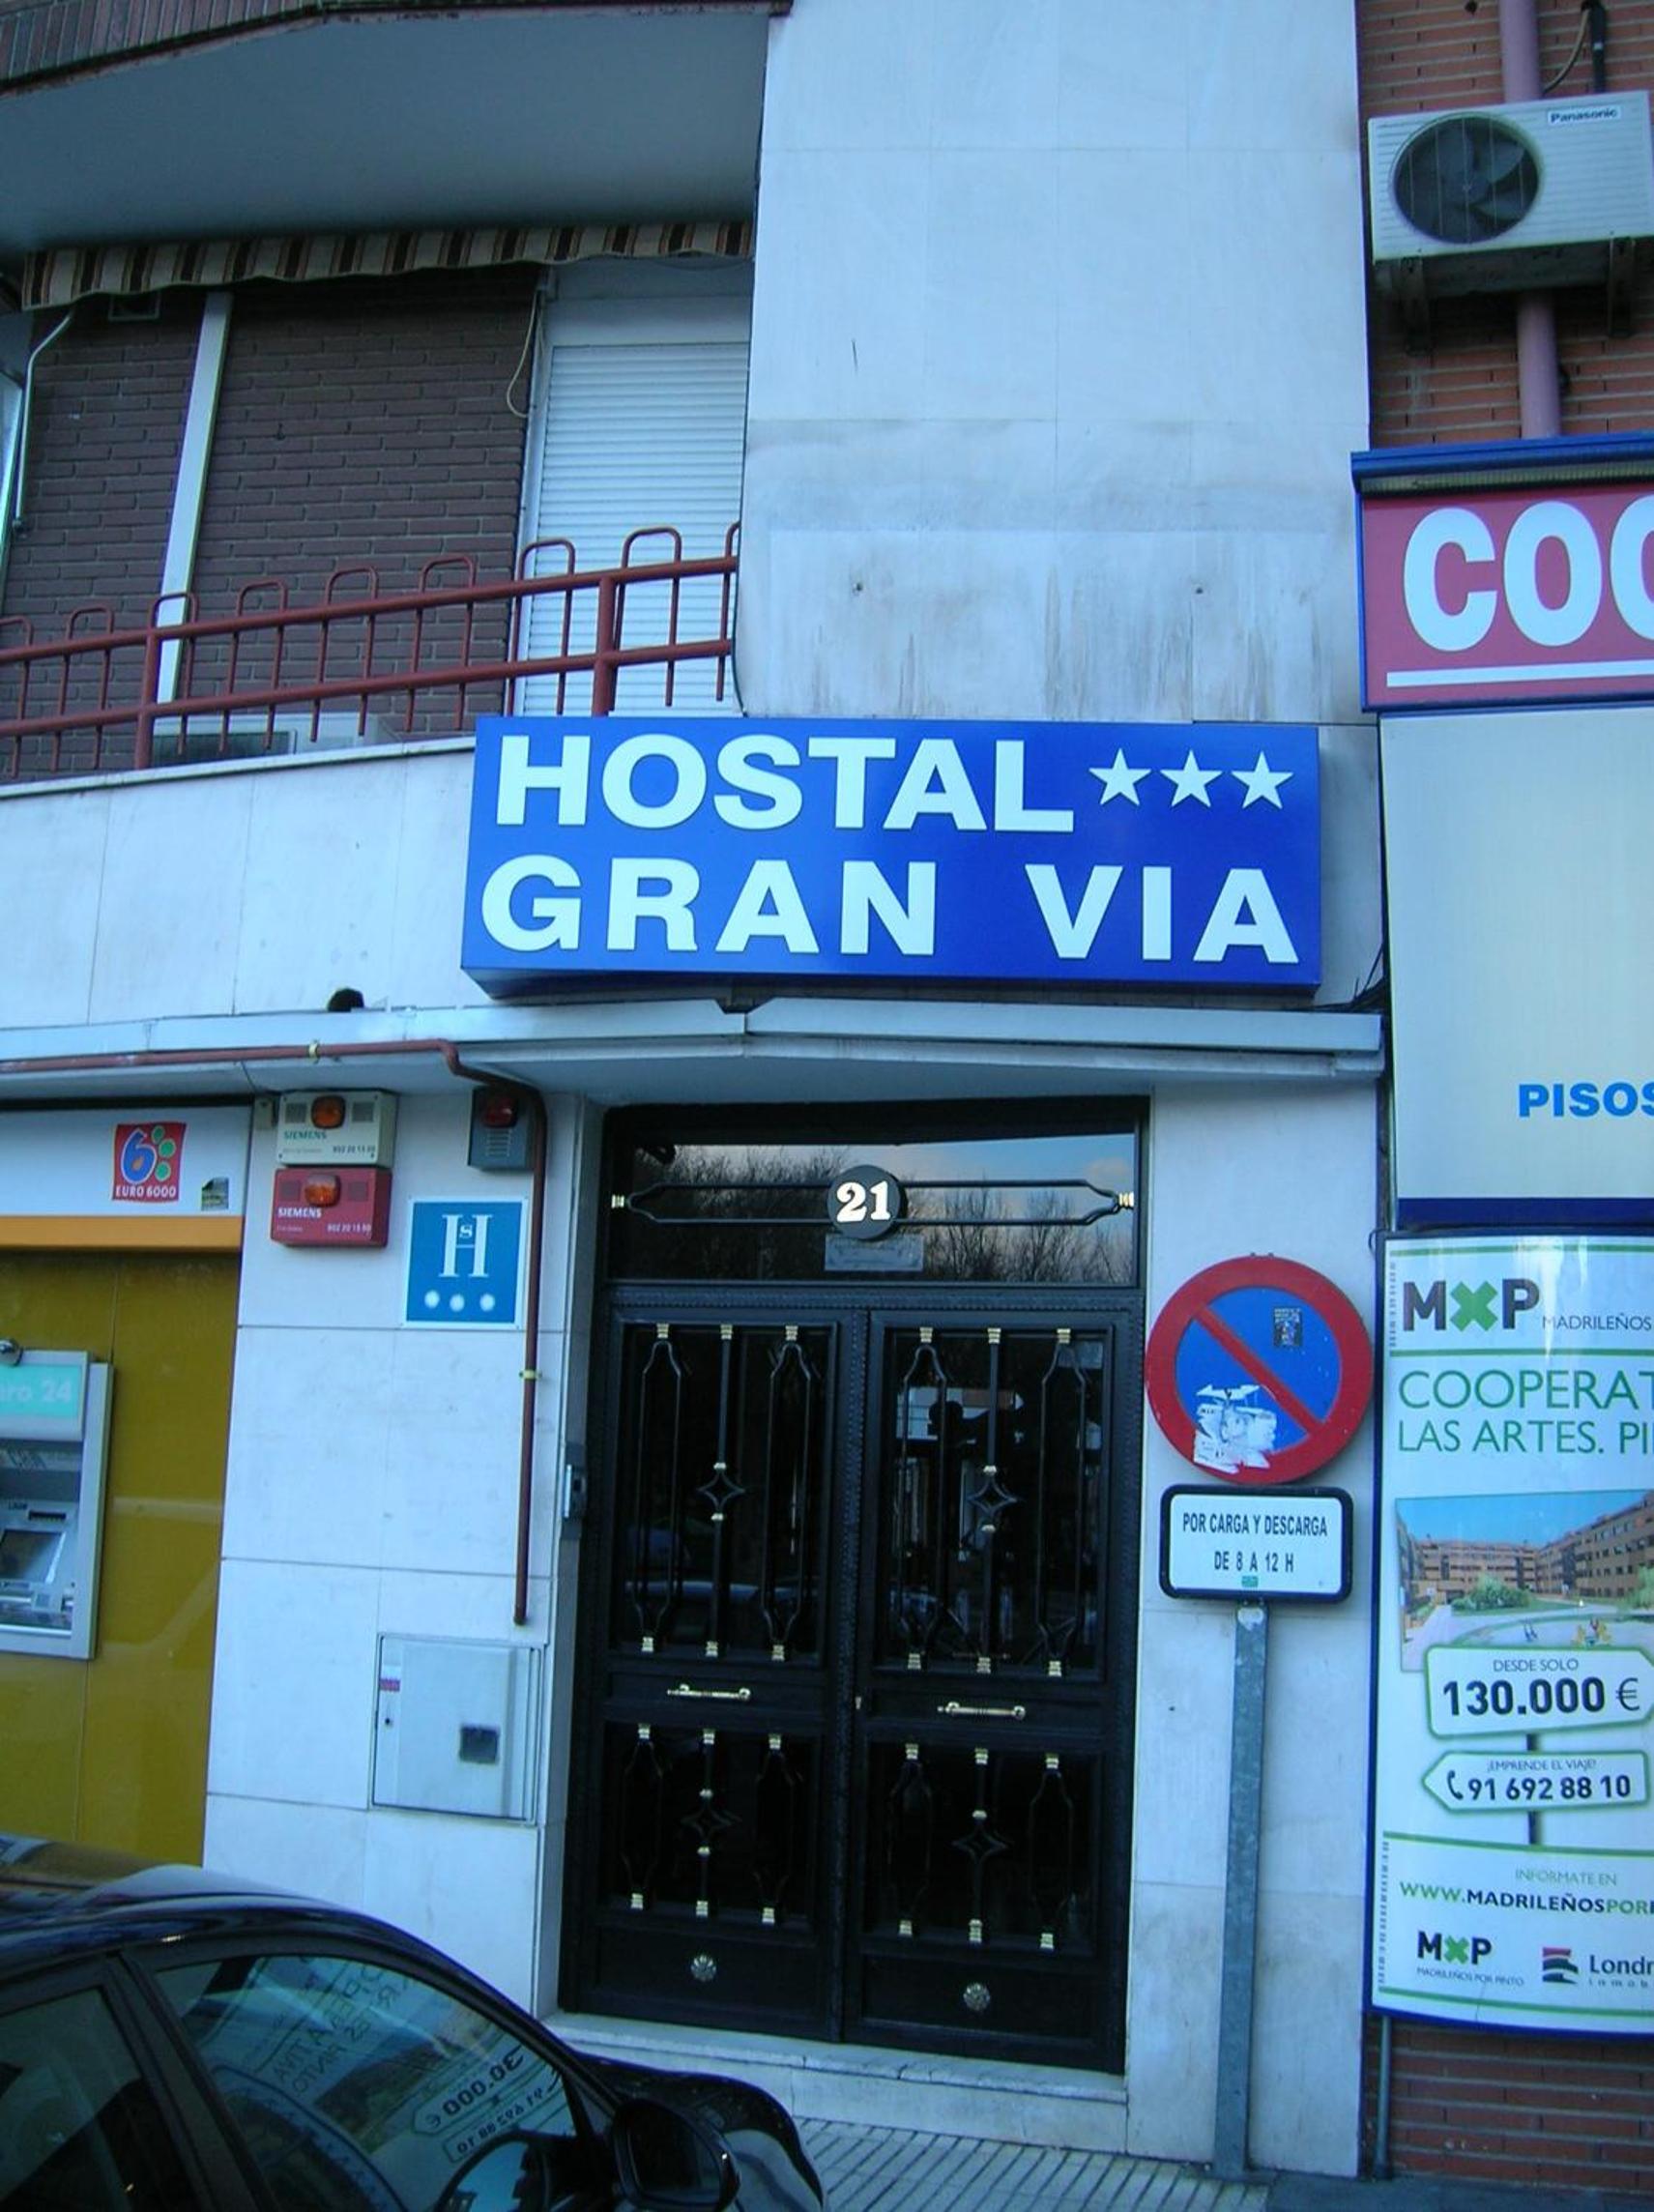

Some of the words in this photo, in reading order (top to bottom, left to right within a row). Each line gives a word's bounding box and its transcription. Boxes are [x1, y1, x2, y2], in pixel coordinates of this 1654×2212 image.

[1551, 108, 1617, 123] Panasonic
[496, 733, 1075, 833] HOSTAL
[480, 854, 936, 956] GRAN
[1025, 864, 1300, 965] VIA
[284, 1130, 327, 1140] SIEMENS
[116, 1185, 144, 1197] EURO
[146, 1185, 176, 1197] 6000
[836, 1180, 890, 1223] 21
[278, 1207, 322, 1218] SIEMENS
[1542, 1313, 1652, 1331] MADRILEÑOS
[1399, 1420, 1461, 1452] LAS
[1472, 1420, 1604, 1454] ARTES.
[1619, 1422, 1654, 1454] PI
[1183, 1512, 1206, 1532] POR
[1209, 1513, 1250, 1534] CARGA
[1252, 1515, 1261, 1534] Y
[1264, 1515, 1327, 1536] DESCARGA
[1214, 1551, 1230, 1571] DE
[1236, 1551, 1243, 1571] 8
[1249, 1552, 1258, 1572] A
[1265, 1553, 1278, 1572] 12
[1286, 1554, 1294, 1573] H
[1494, 1659, 1538, 1673] DESDE
[1540, 1658, 1580, 1672] SOLO
[1443, 1676, 1605, 1716] 130.000
[1551, 1760, 1562, 1770] EL
[1468, 1777, 1496, 1801] 91
[1505, 1777, 1553, 1800] 692
[1560, 1776, 1593, 1799] 88
[1601, 1774, 1631, 1798] 10
[1515, 1869, 1595, 1885] INFORMATE
[1599, 1873, 1617, 1886] EN
